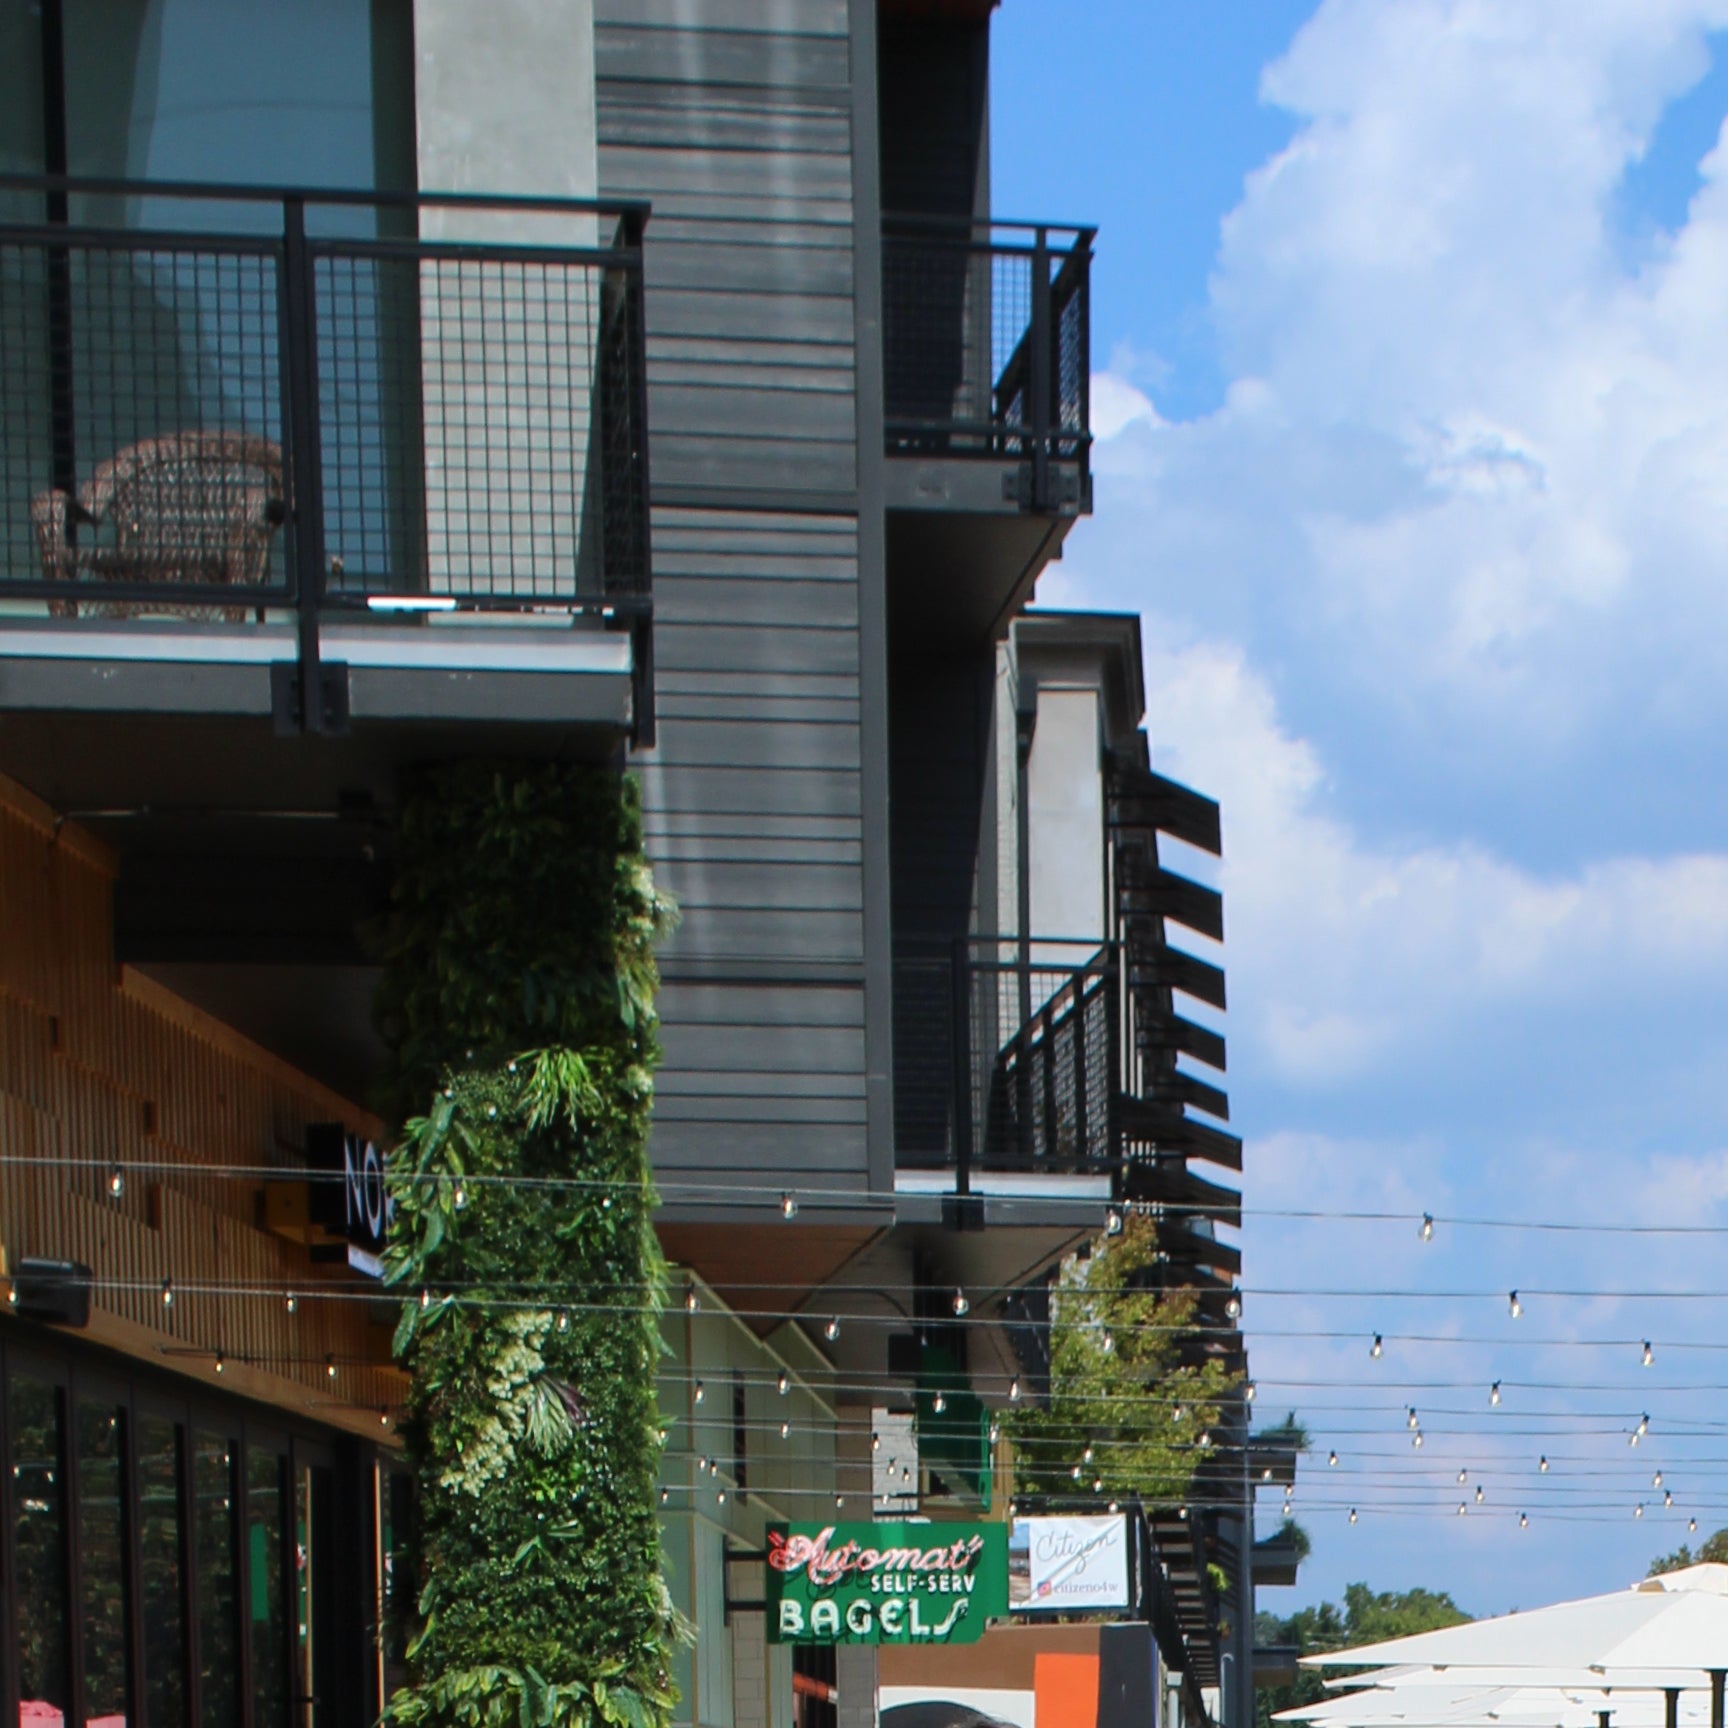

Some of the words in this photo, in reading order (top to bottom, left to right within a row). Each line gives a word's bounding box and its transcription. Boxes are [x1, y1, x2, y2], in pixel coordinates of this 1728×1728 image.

[769, 1527, 978, 1585] Automat
[1036, 1530, 1118, 1575] Citizen
[870, 1575, 976, 1593] SELF-SERV
[779, 1598, 969, 1635] BAGELS
